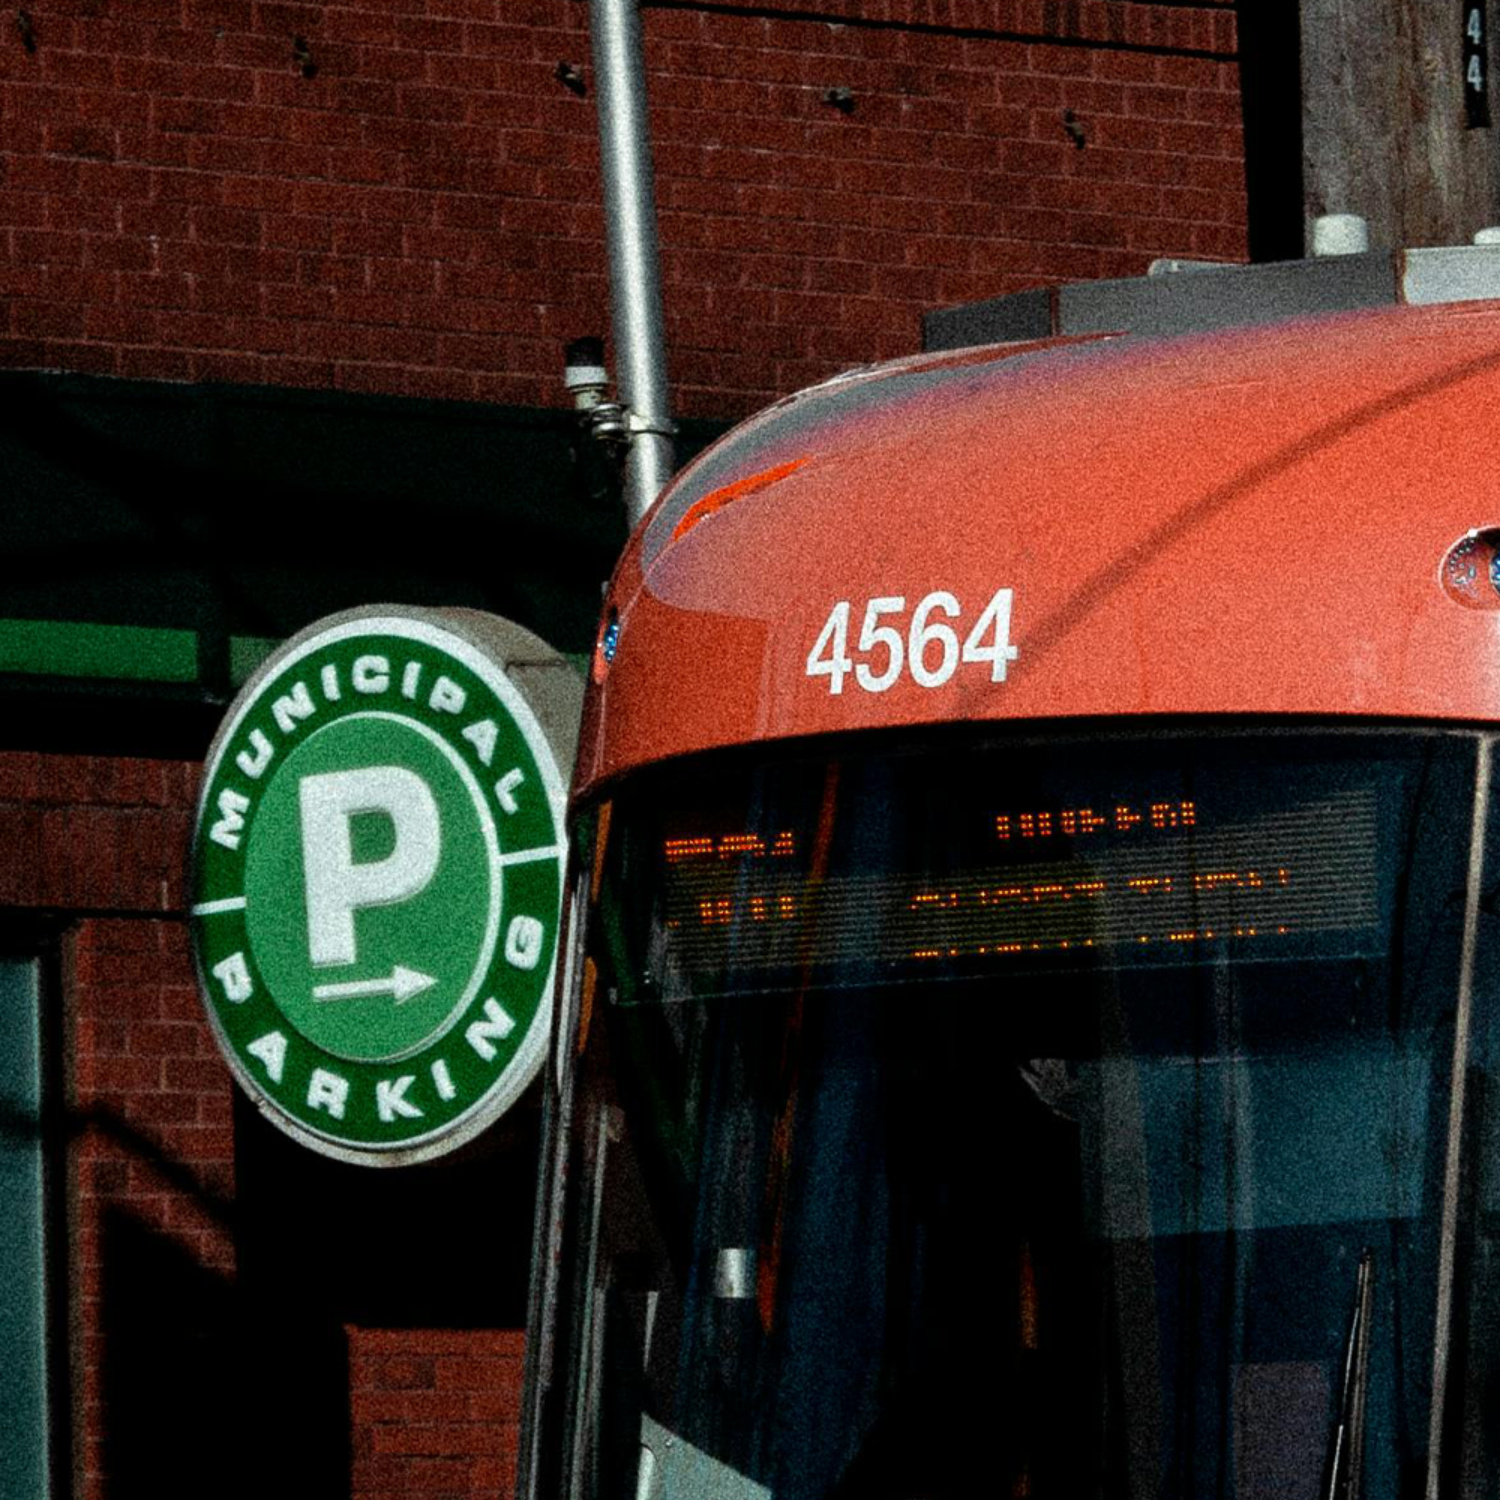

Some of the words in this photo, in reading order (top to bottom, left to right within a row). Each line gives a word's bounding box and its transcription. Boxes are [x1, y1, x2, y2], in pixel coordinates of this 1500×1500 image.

[805, 588, 1019, 695] 4564
[210, 654, 526, 851] MUNICIPAL
[300, 765, 442, 969] P
[212, 914, 544, 1123] PARKING
